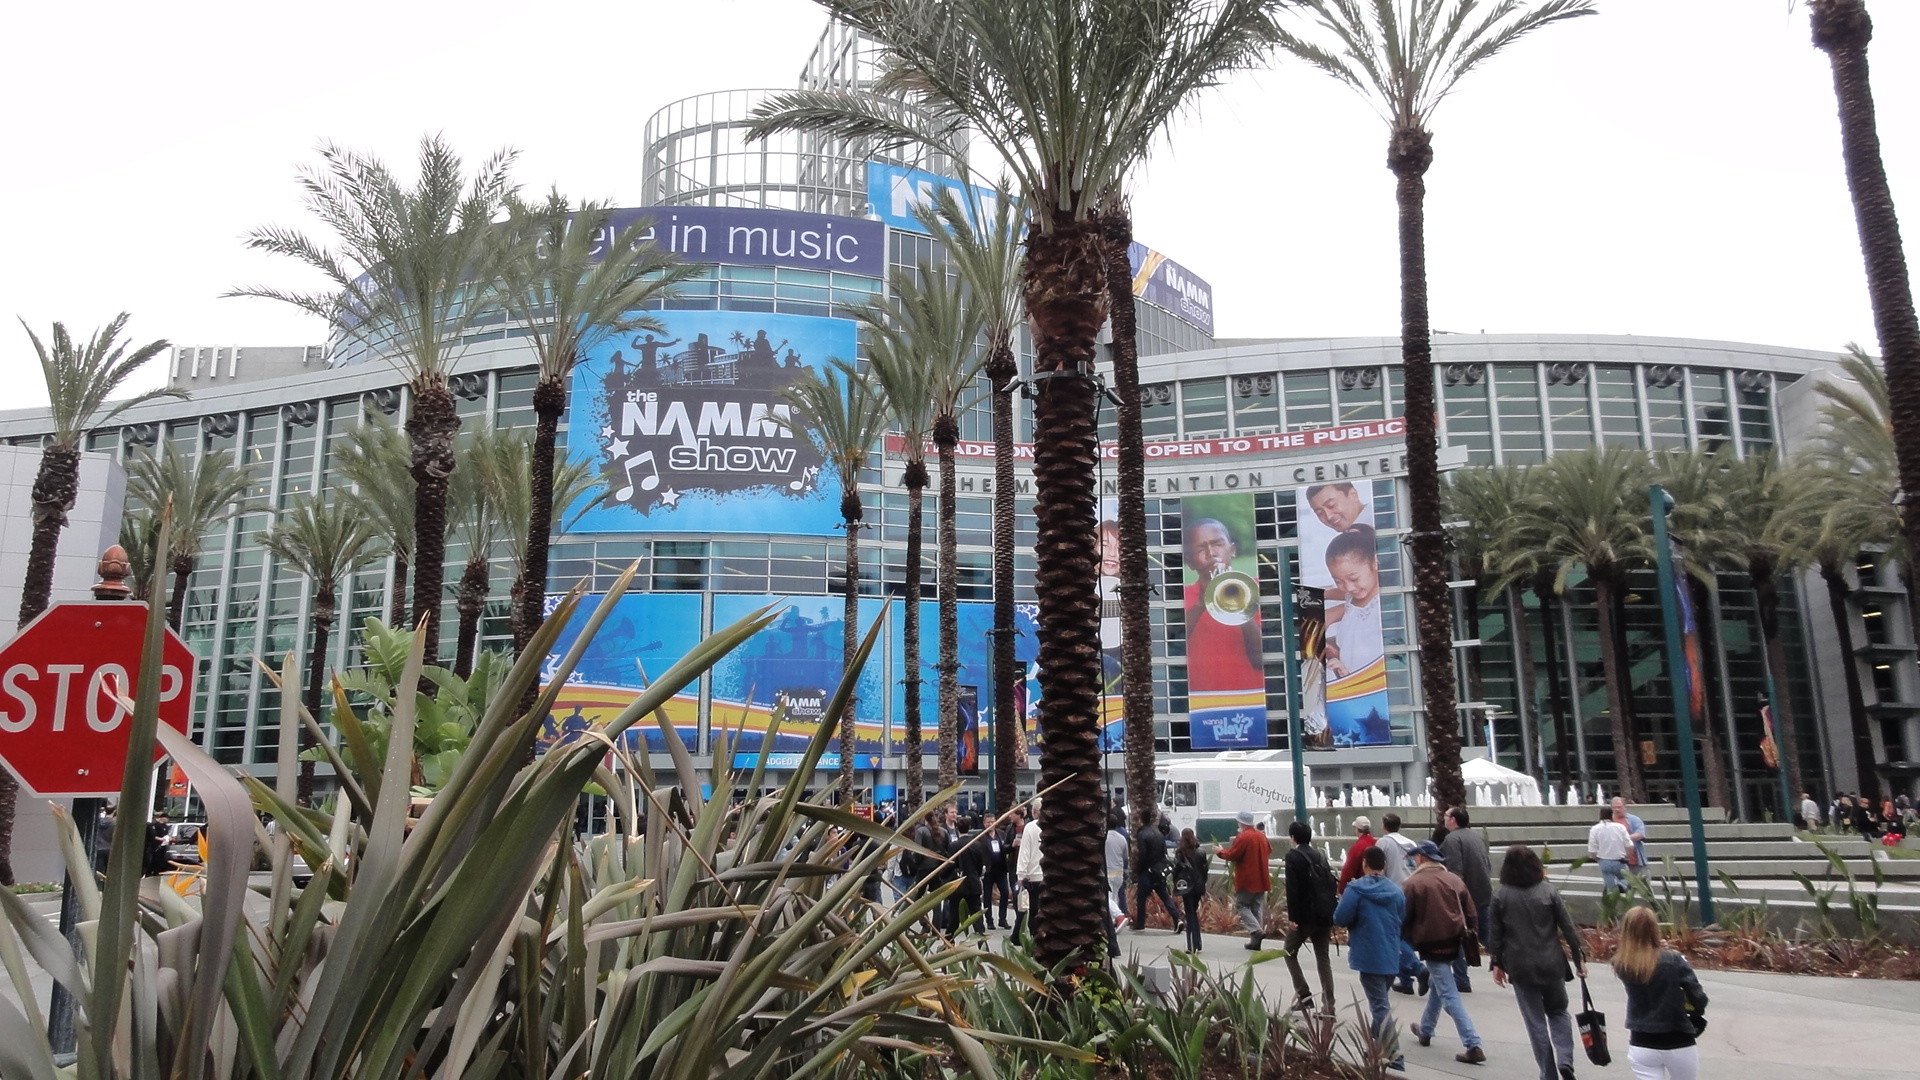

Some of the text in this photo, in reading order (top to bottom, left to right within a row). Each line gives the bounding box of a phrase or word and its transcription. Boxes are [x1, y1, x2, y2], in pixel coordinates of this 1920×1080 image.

[671, 215, 707, 253] in
[728, 223, 859, 263] music
[1165, 268, 1209, 309] NAMM
[626, 389, 657, 402] the
[621, 401, 794, 446] NAMM
[1146, 442, 1211, 457] OPEN
[1218, 439, 1251, 452] TO
[1258, 434, 1306, 449] THE
[1314, 421, 1403, 445] PUBLIC
[669, 438, 797, 473] show
[0, 663, 184, 733] STOP
[1213, 716, 1254, 741] play?
